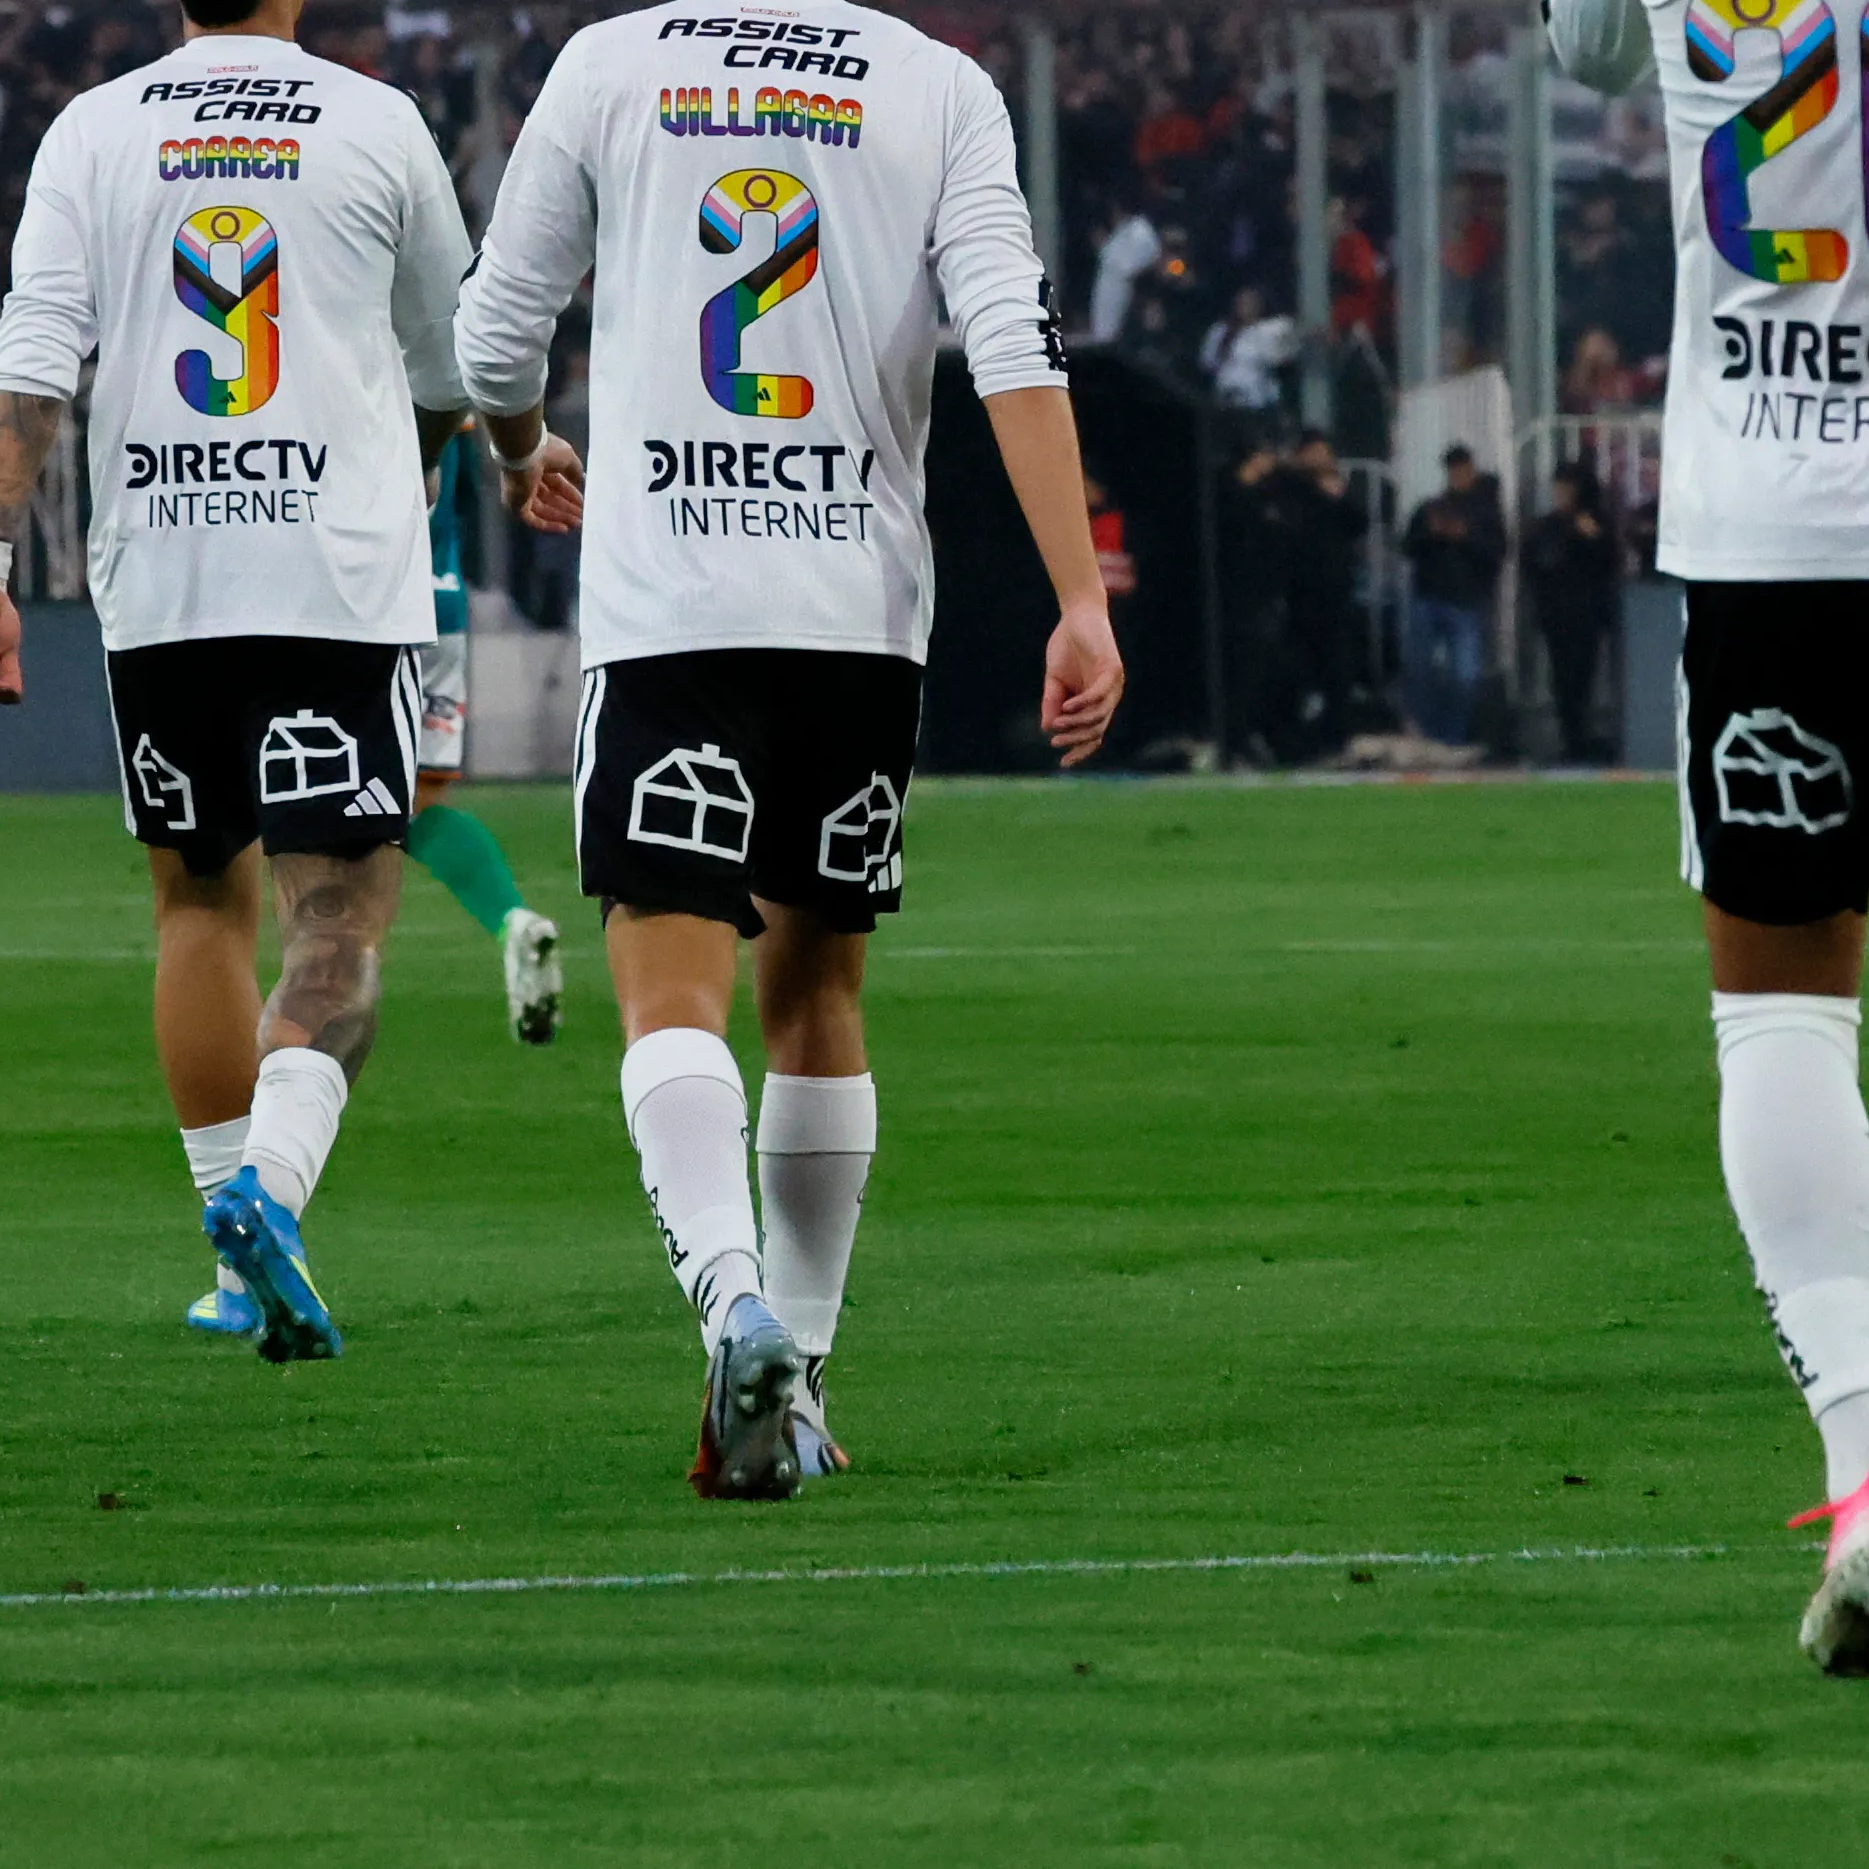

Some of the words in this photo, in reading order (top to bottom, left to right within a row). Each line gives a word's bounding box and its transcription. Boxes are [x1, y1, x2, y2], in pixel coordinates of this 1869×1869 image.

[658, 17, 860, 48] ASSIST
[723, 45, 870, 81] CARD
[140, 78, 314, 105] ASSIST
[194, 101, 322, 125] CARD
[660, 86, 863, 149] VILLAGRA
[159, 135, 301, 182] CORREA
[173, 205, 279, 417] 9
[698, 168, 819, 419] 2
[125, 439, 328, 489] DIRECTV
[643, 439, 875, 493] DIRECTV
[148, 489, 320, 528] INTERNET
[670, 496, 873, 541] INTERNET
